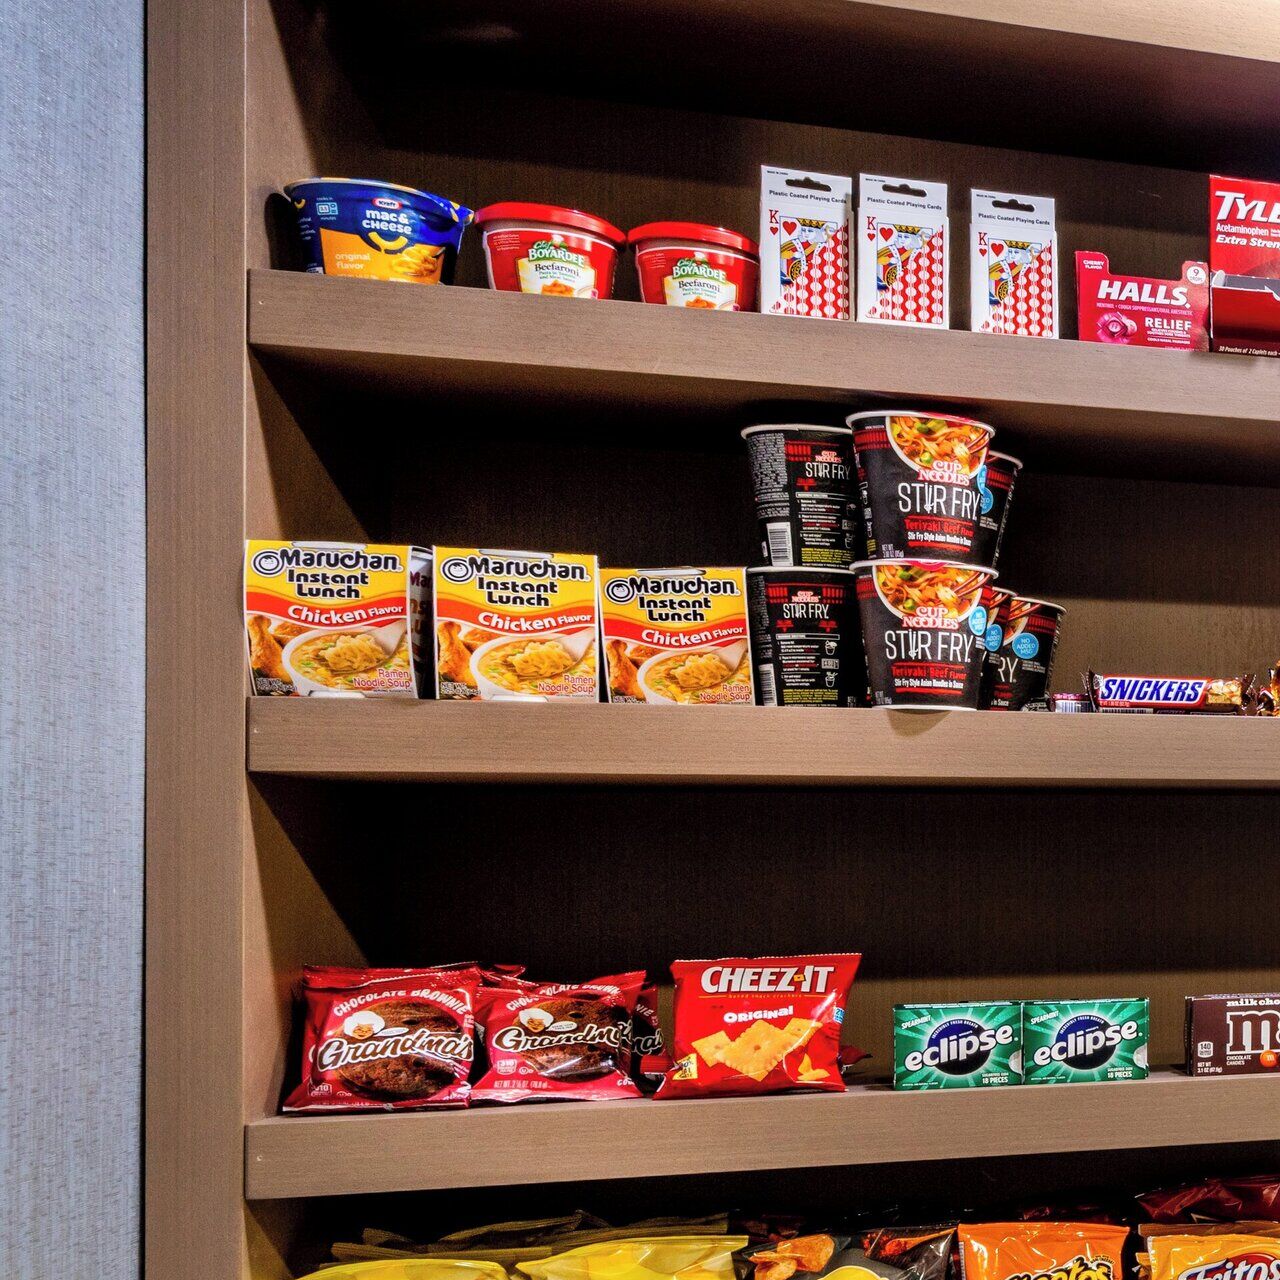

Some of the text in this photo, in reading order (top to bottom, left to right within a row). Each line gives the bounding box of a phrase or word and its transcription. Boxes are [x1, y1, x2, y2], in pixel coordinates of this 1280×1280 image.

[768, 189, 830, 203] Plastic Coated Playing
[866, 197, 885, 205] Plastic
[885, 198, 905, 206] Coated
[906, 200, 926, 209] Playing
[377, 200, 398, 208] Kraft
[1015, 217, 1035, 225] Playing
[1216, 223, 1269, 236] Acetaminophen
[1216, 235, 1248, 245] Extra
[335, 253, 371, 263] original
[527, 249, 585, 268] BOYARDEE
[336, 262, 365, 270] flavor
[672, 265, 727, 283] BOYARDEE
[1097, 279, 1189, 307] HALLS
[1145, 317, 1192, 330] RELIEF
[932, 460, 963, 472] CUP
[918, 468, 970, 485] NOODLES
[897, 482, 981, 520] STIR FRY
[904, 517, 942, 532] Teriyaki
[280, 549, 398, 571] Maruchan
[468, 556, 586, 580] Maruchan
[287, 569, 369, 585] Instant
[297, 585, 360, 599] Lunch
[477, 577, 558, 593] Instant
[629, 577, 736, 595] Maruchan
[487, 591, 550, 607] Lunch
[639, 596, 711, 610] Instant
[287, 605, 404, 624] Chicken Flavor
[648, 610, 705, 622] Lunch
[915, 607, 949, 618] CUP
[478, 612, 592, 632] Chicken Flavor
[902, 614, 959, 630] NOODLES
[641, 627, 744, 646] Chicken Flavor
[885, 630, 971, 662] STIR FRY
[378, 669, 409, 678] Ramen
[564, 675, 594, 684] Ramen
[353, 678, 411, 689] Noodle Soup
[538, 683, 594, 694] Noodle Soup
[1100, 678, 1204, 702] SNICKERS
[700, 693, 750, 701] Noodle Soup
[700, 965, 834, 993] CHEEZ-IT
[333, 988, 468, 1017] CHOCOLATE BROWNIE
[1226, 999, 1258, 1007] milk
[901, 1014, 931, 1030] SPEARMINT
[1030, 1010, 1060, 1025] SPEARMINT
[317, 1028, 475, 1073] Grandma's
[904, 1024, 1014, 1072] eclipse
[1033, 1020, 1139, 1067] eclipse
[989, 1076, 1009, 1084] PIECES
[1114, 1071, 1133, 1079] PIECES
